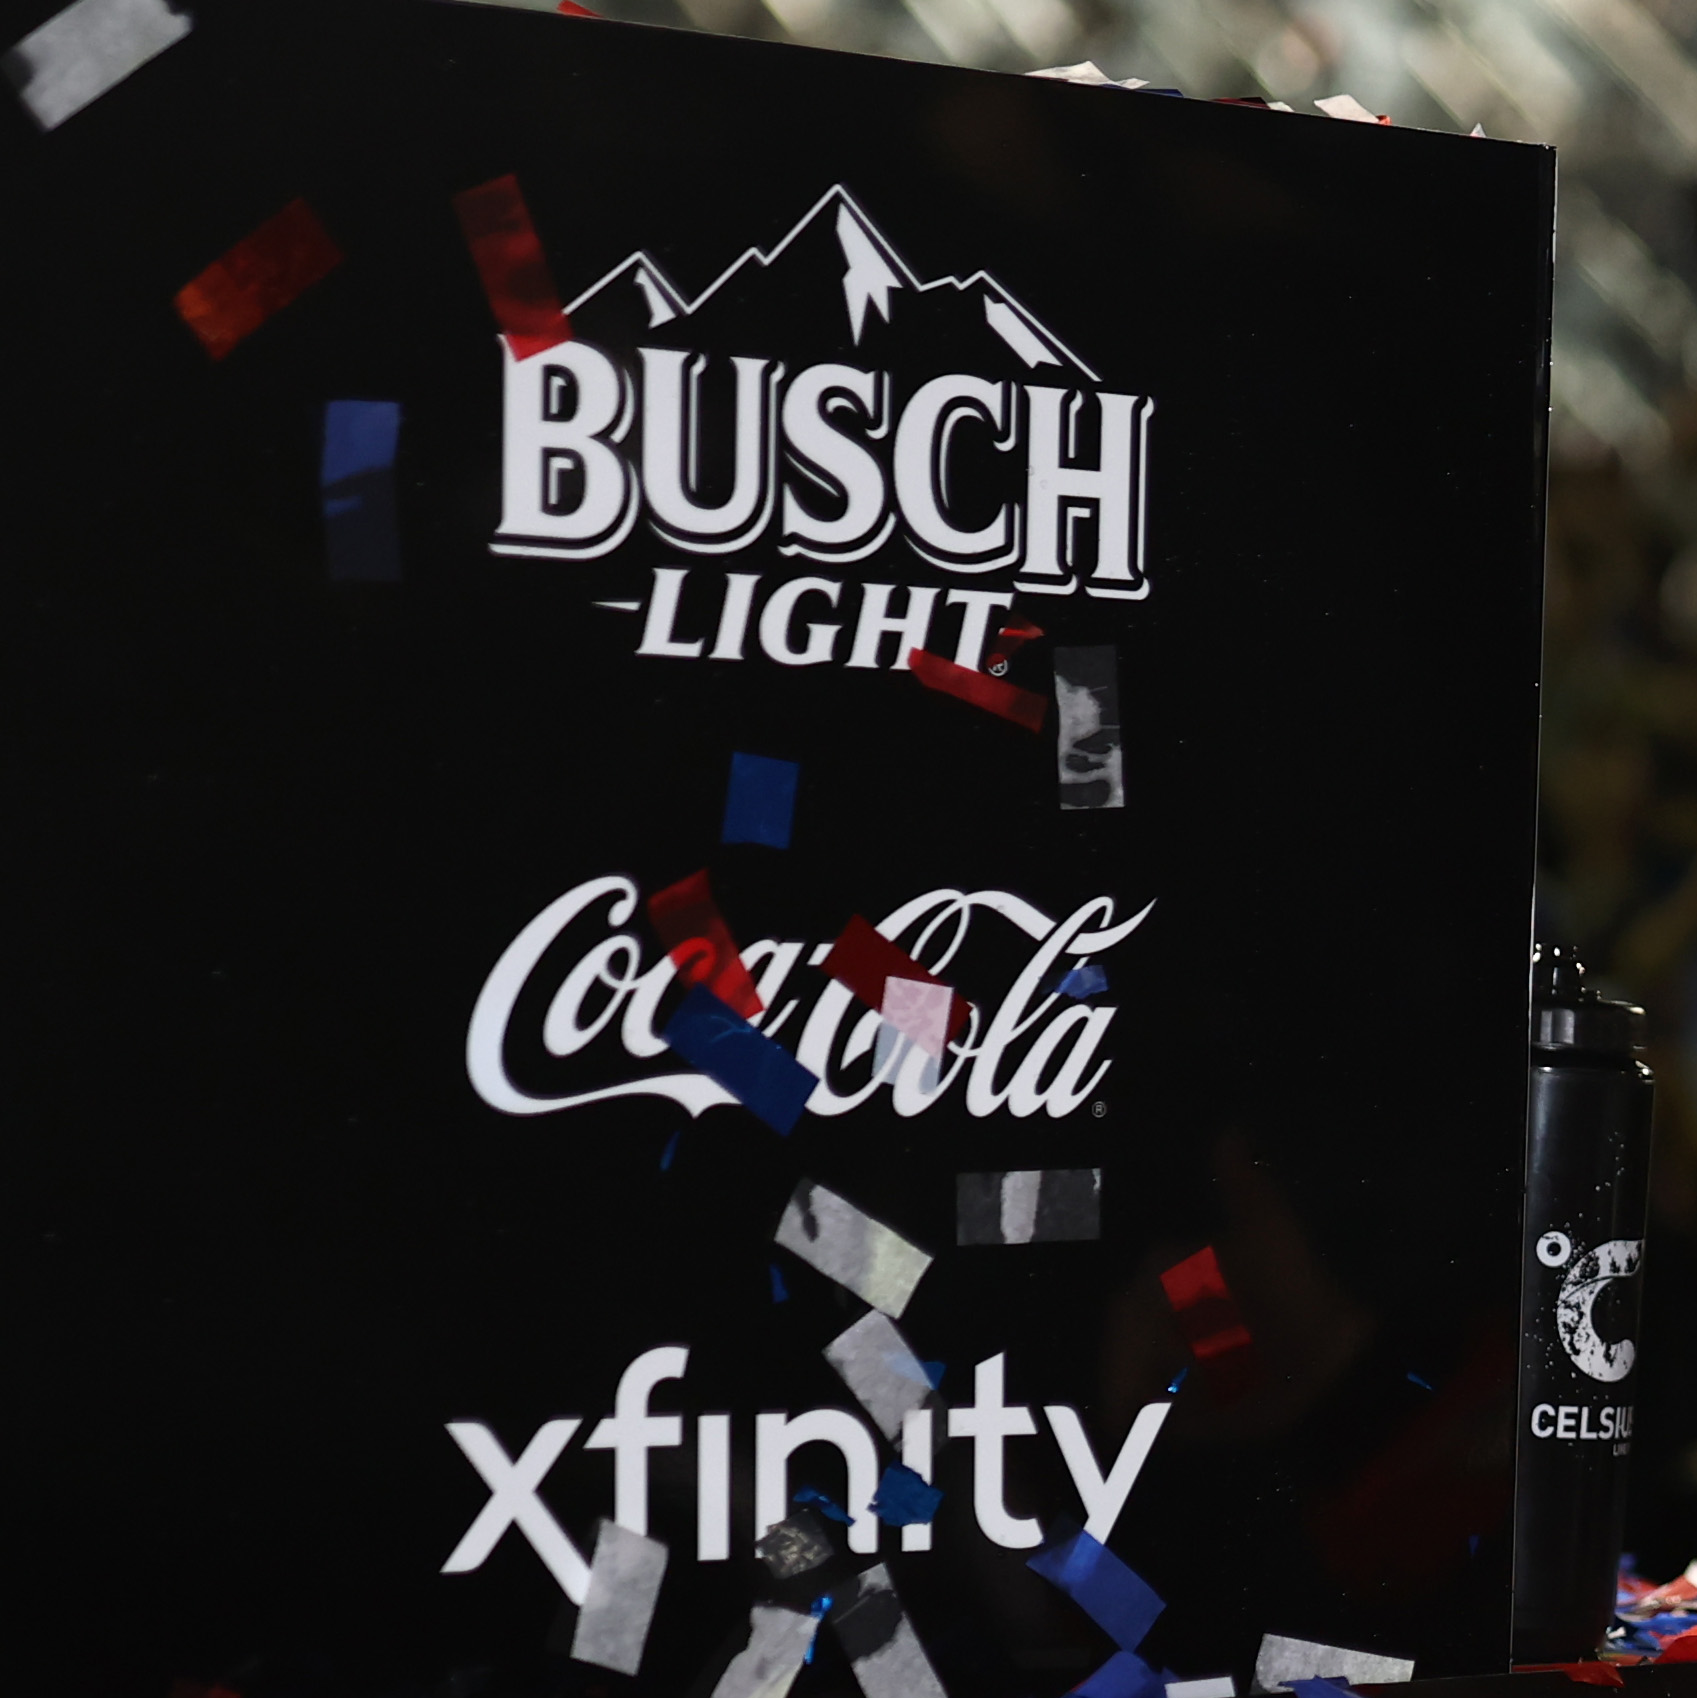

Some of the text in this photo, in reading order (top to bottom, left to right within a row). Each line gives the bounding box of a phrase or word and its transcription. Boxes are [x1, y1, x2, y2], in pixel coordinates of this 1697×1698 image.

[488, 333, 1155, 602] BUSCH
[634, 566, 1014, 672] LIGHT
[440, 1344, 1172, 1606] xfinity
